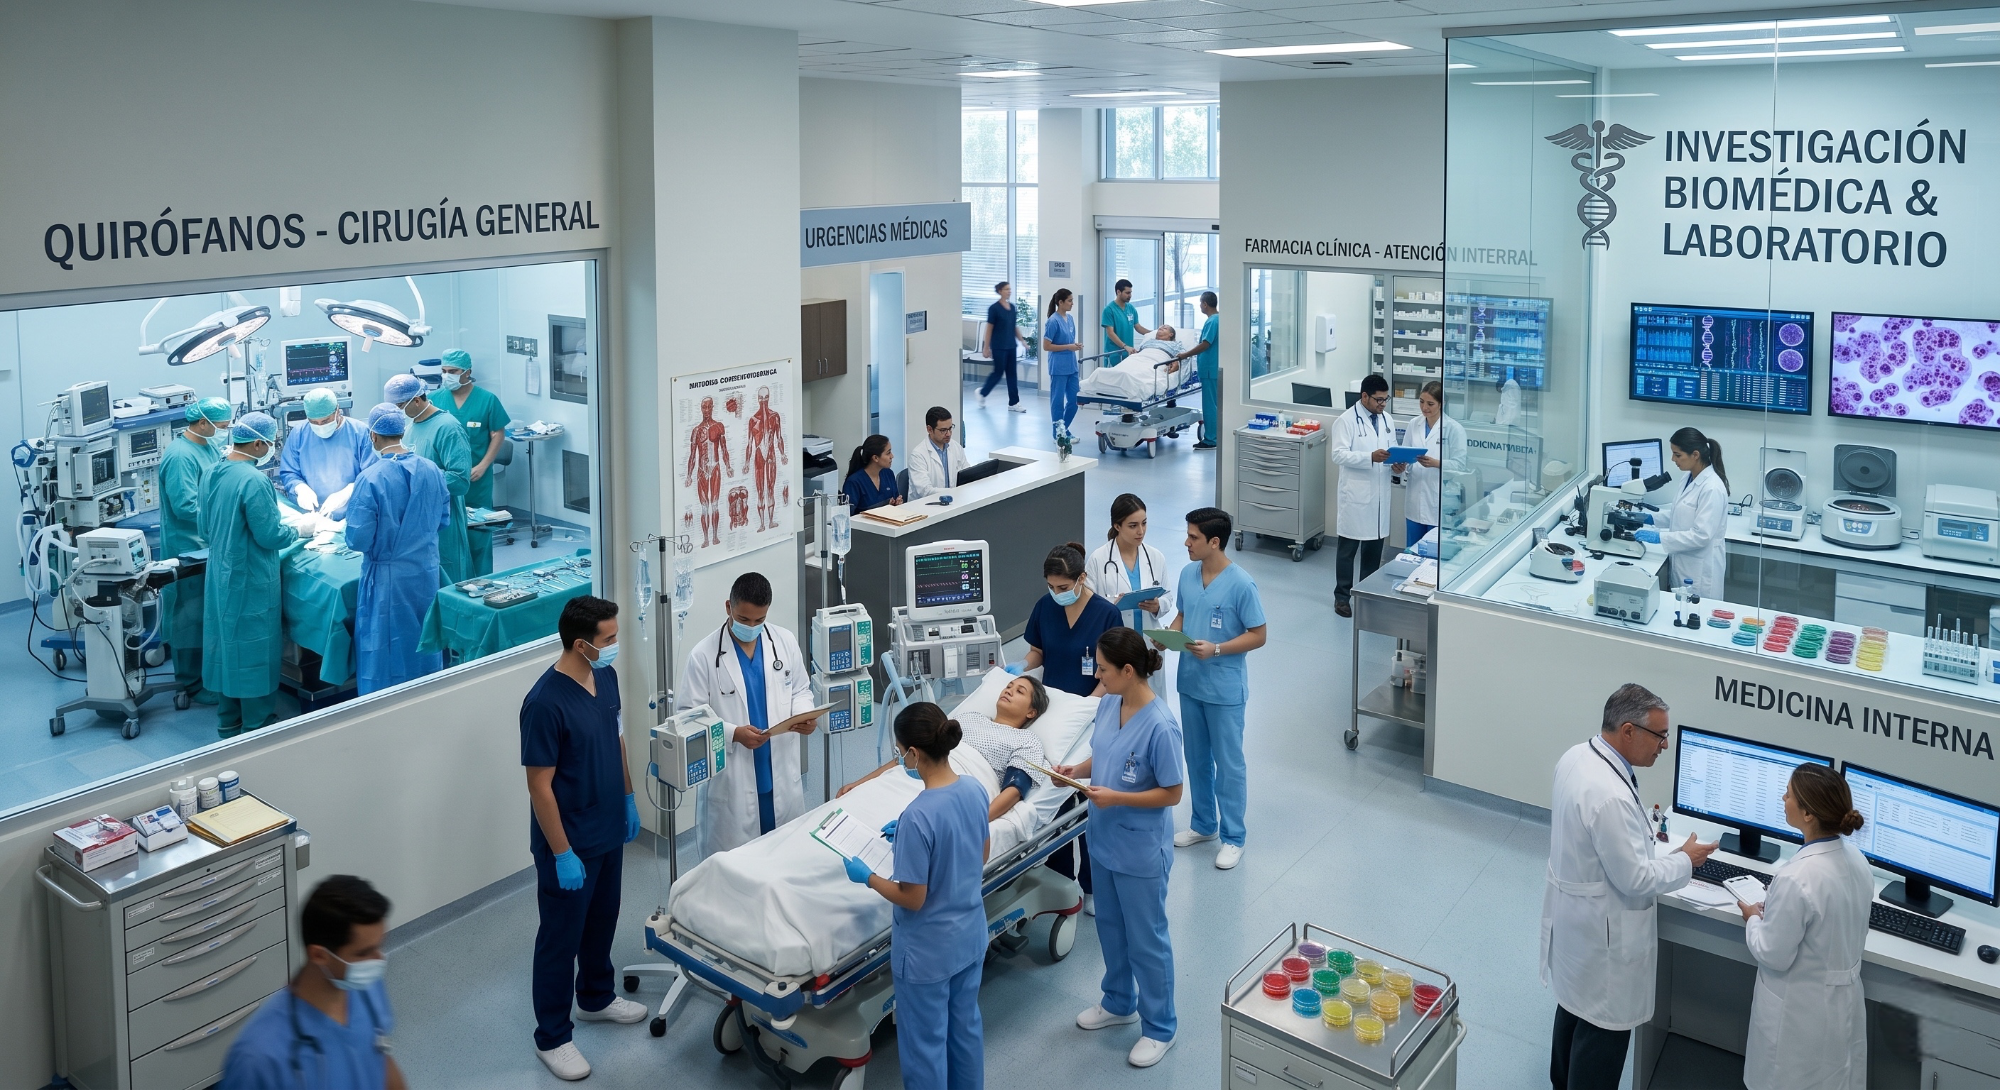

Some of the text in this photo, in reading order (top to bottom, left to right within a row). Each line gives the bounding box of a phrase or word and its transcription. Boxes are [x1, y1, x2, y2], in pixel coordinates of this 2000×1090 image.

[1665, 117, 1967, 164] INVESTIGACIÓN
[1664, 167, 1938, 217] BIOMÉDICA &
[44, 206, 306, 271] QUIRÓFANOS
[337, 197, 469, 245] CIRUGÍA
[475, 200, 600, 237] GENERAL
[805, 215, 948, 249] URGENCIAS MÉDICAS
[1245, 238, 1313, 256] FARMACIA
[1316, 238, 1372, 258] CLÍNICA
[1384, 242, 1457, 262] ATENCIÓN
[1462, 247, 1538, 266] INTERRAL
[1663, 222, 1947, 268] LABORATORIO
[1715, 676, 1995, 760] MEDICINA INTERNA
